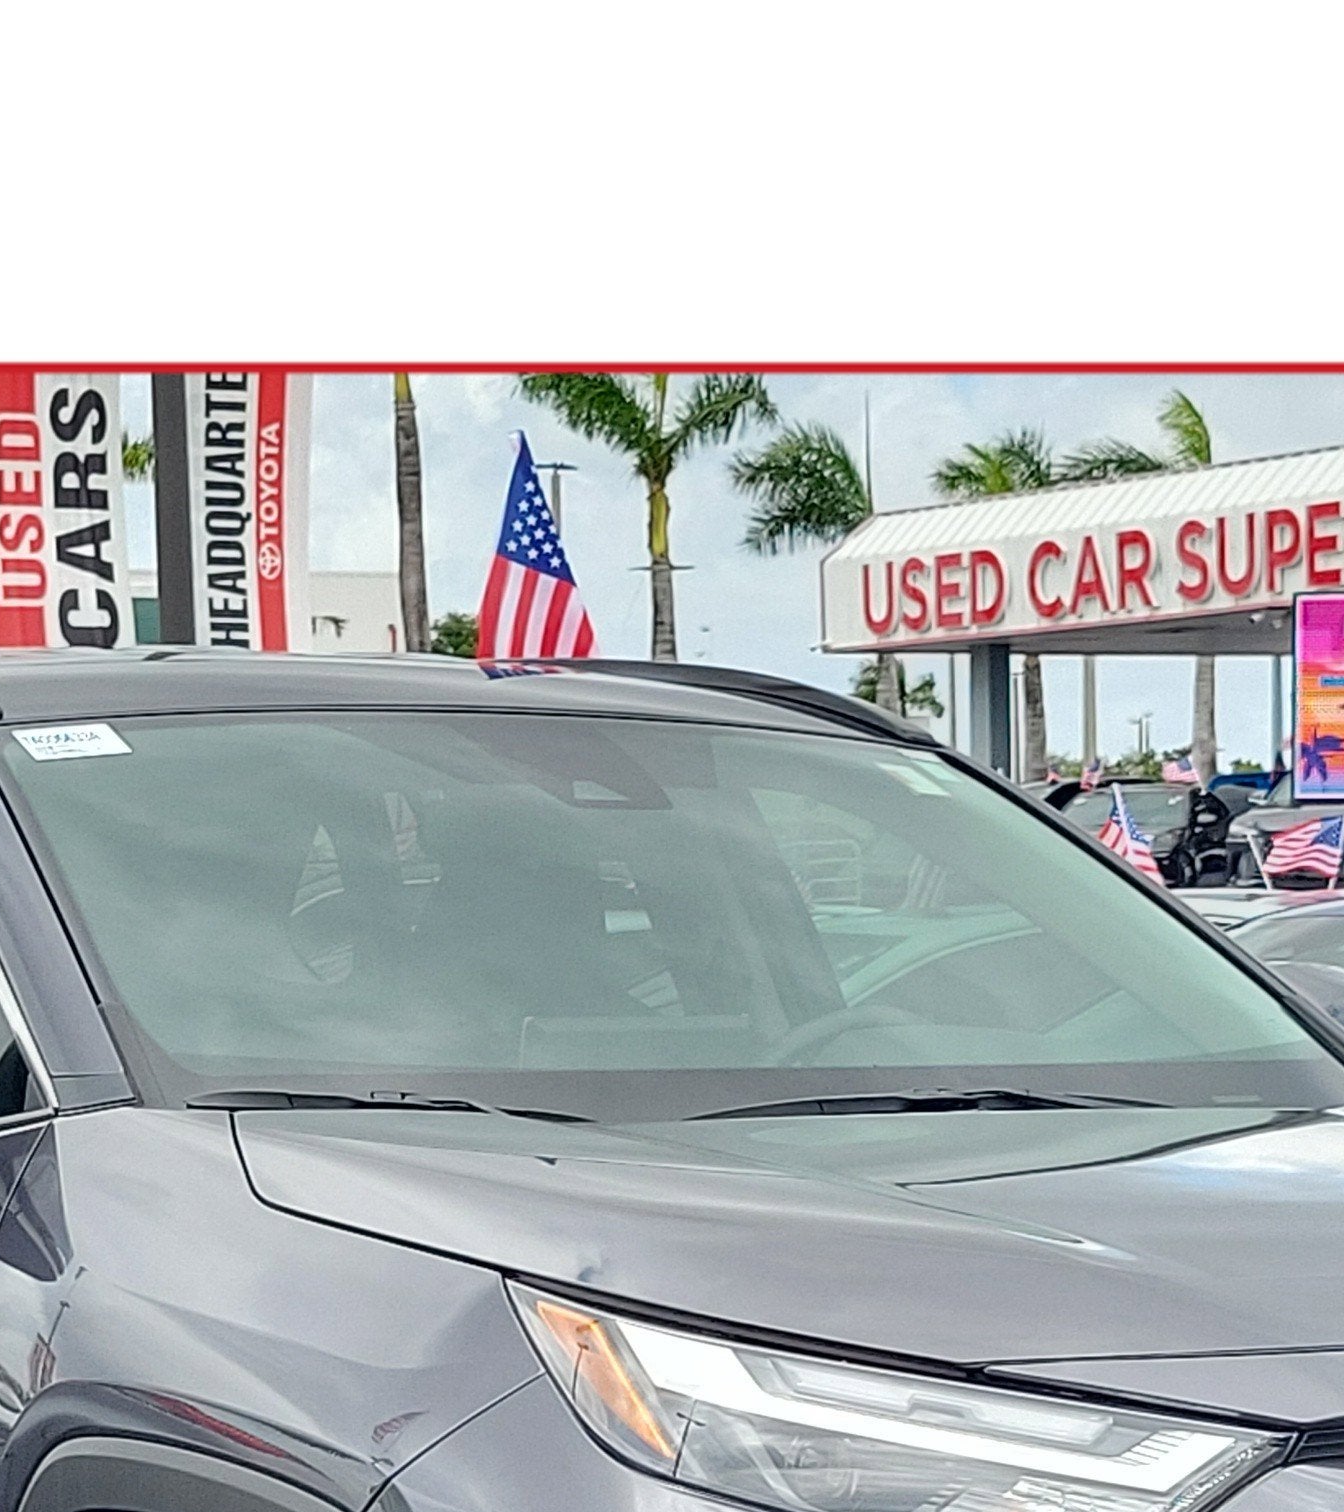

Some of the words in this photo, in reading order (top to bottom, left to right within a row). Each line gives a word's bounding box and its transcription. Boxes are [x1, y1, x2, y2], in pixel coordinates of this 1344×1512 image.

[49, 387, 120, 649] CARS
[205, 372, 252, 648] HEADQUARTE
[259, 421, 282, 539] TOYOTA
[862, 548, 1006, 636] USED
[1026, 529, 1158, 618] CAR
